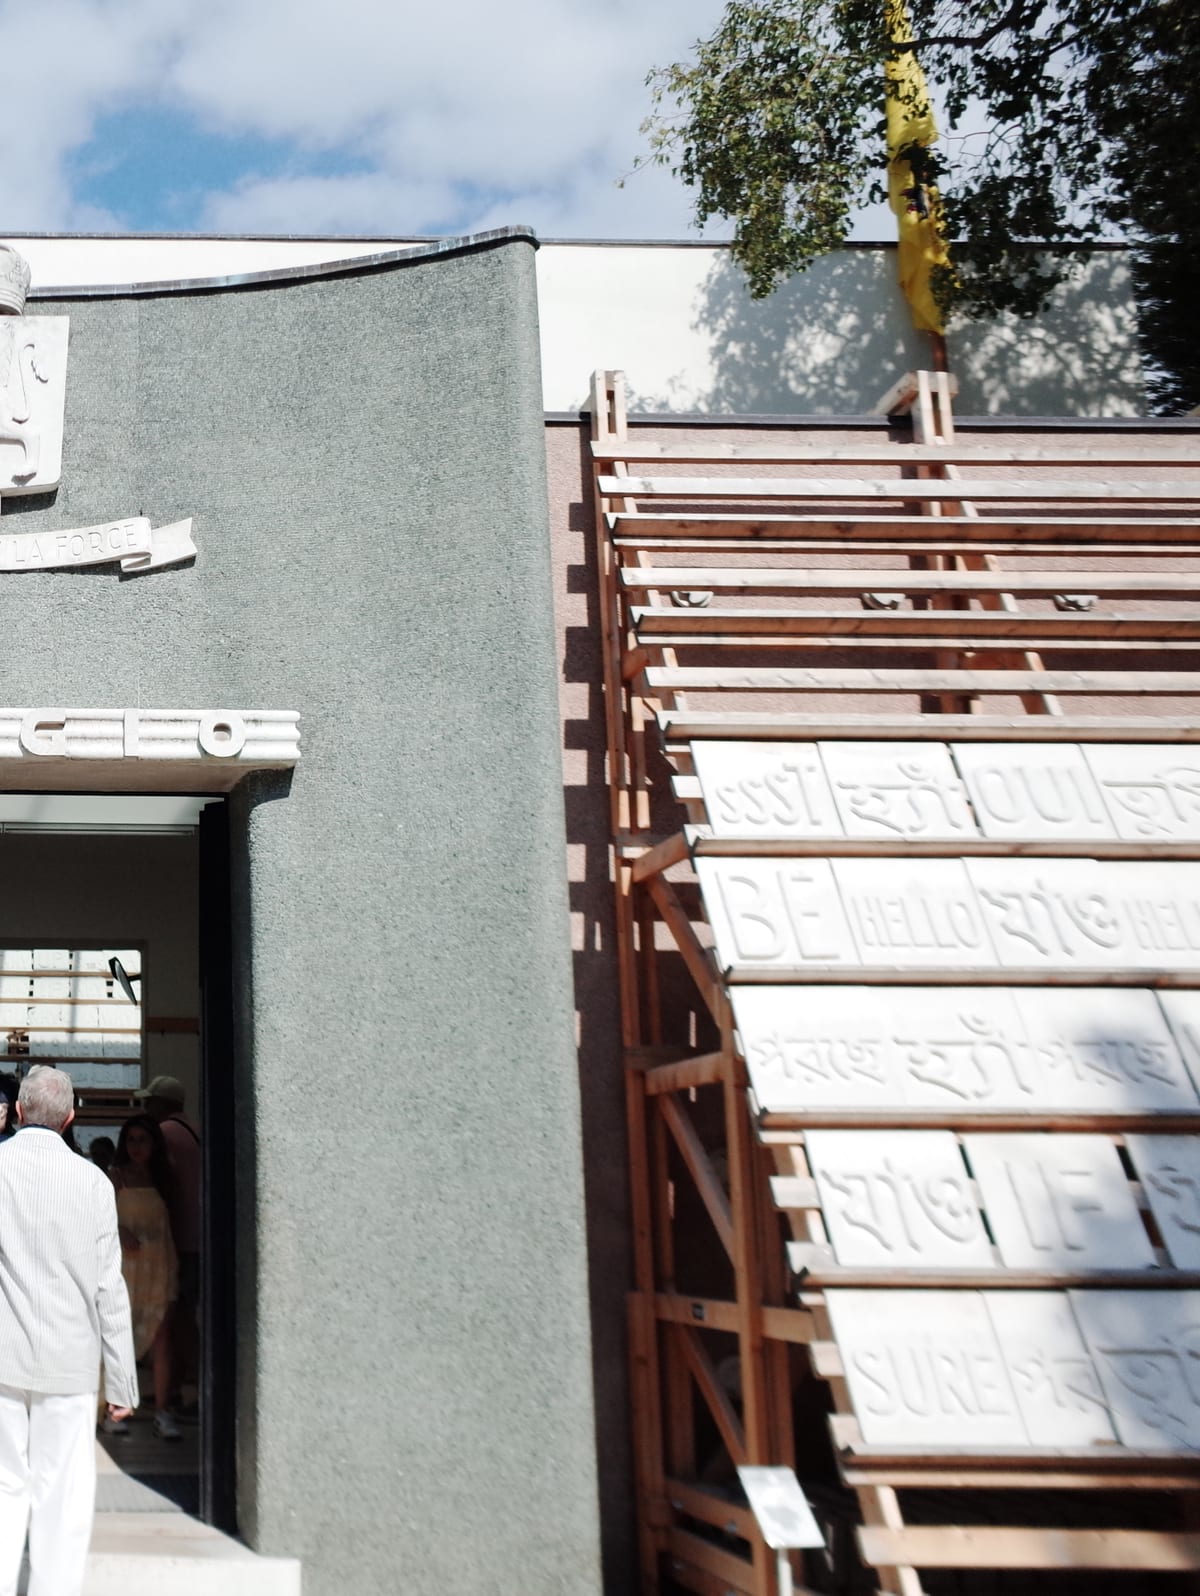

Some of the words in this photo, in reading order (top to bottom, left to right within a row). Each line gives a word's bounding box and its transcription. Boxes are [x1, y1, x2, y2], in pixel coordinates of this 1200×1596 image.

[12, 539, 44, 563] LA
[55, 522, 138, 560] FORCE
[714, 761, 818, 827] SSST
[971, 765, 1106, 825] OUI
[713, 868, 841, 961] BE
[849, 895, 984, 949] HELLO
[1003, 1159, 1100, 1252] IF
[851, 1348, 1013, 1416] SURE
